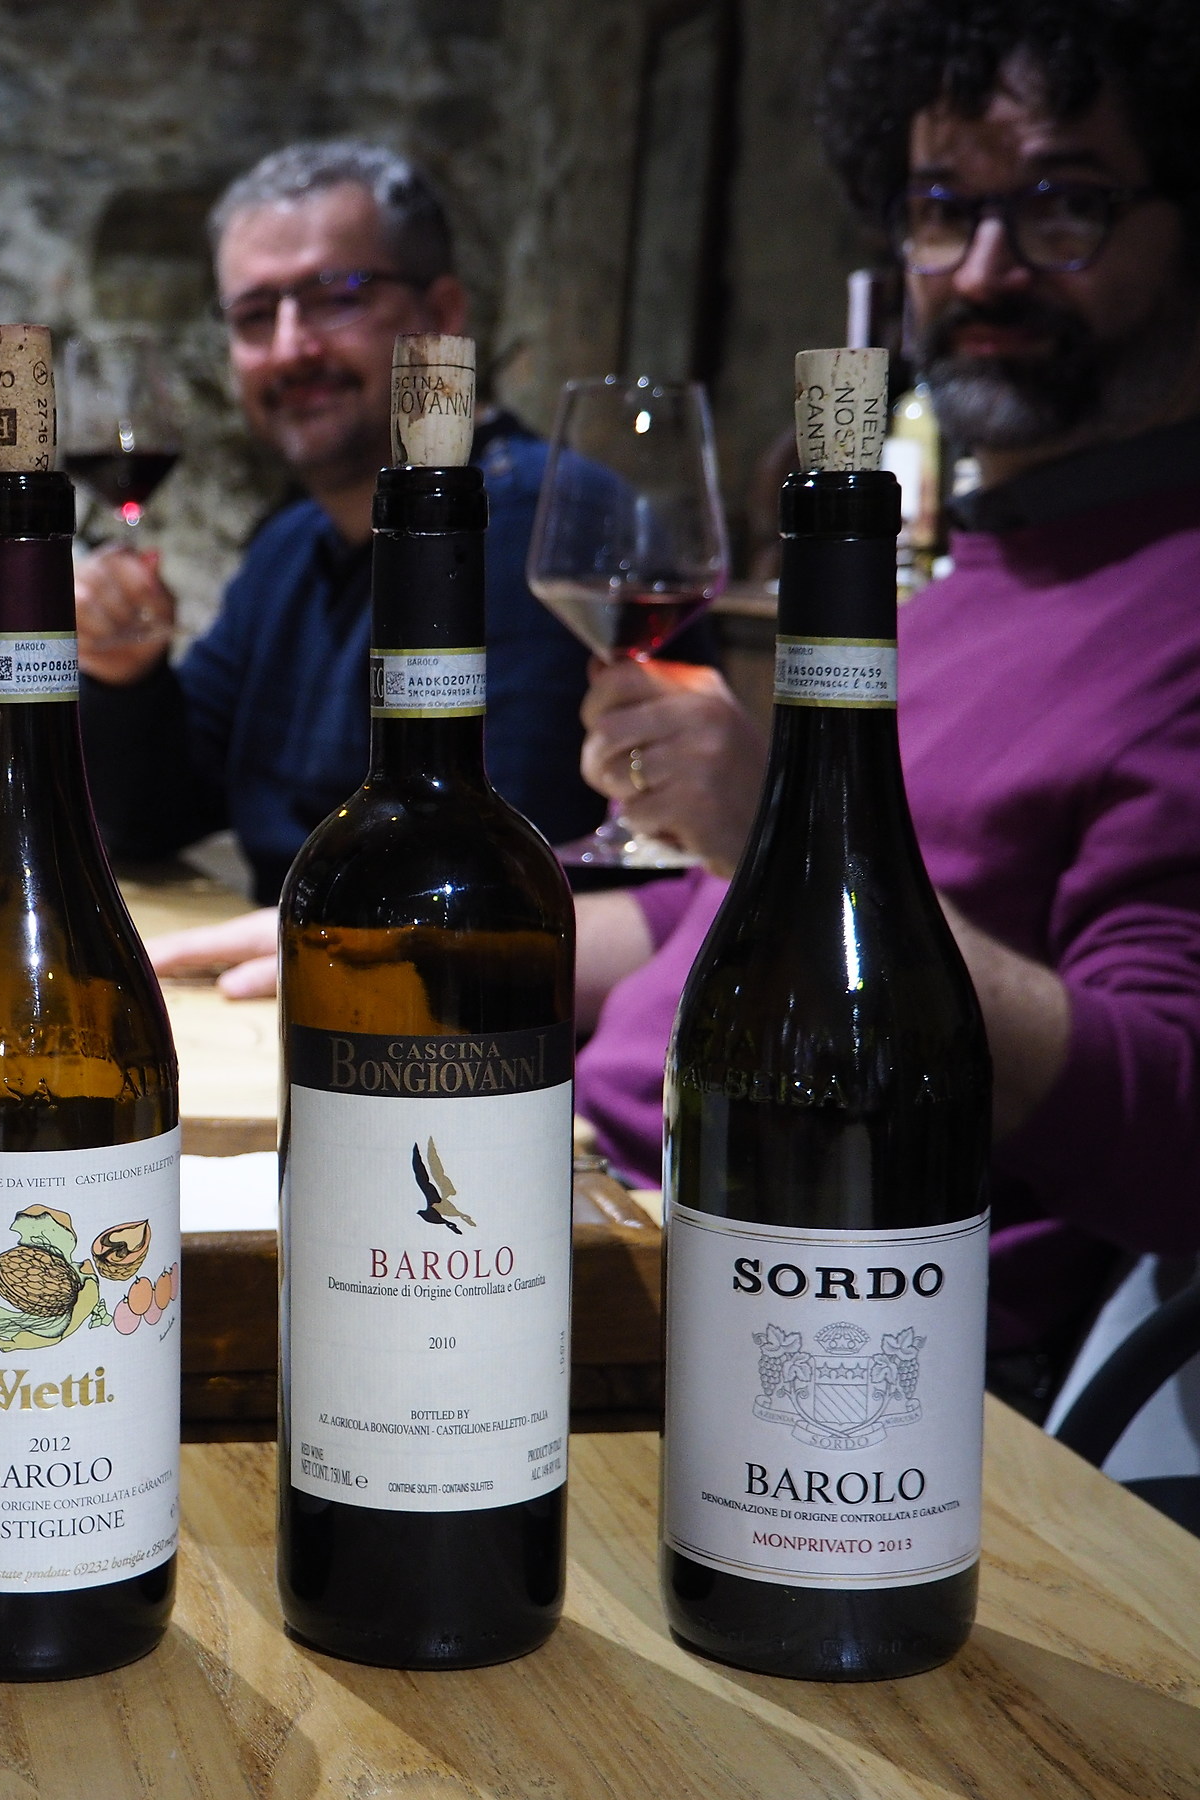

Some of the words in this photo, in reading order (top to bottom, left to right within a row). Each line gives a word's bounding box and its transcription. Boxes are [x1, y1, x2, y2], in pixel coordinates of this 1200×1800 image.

[37, 398, 48, 444] 27-16
[14, 642, 46, 651] BAROLO
[406, 658, 439, 666] BAROLO
[388, 1041, 500, 1060] CASCINA
[329, 1034, 548, 1093] BONGIOVANNI
[6, 1178, 24, 1188] DA
[27, 1176, 66, 1188] VIETTI
[75, 1166, 142, 1187] CASTIGLIONE
[143, 1155, 174, 1175] FALLETTO
[370, 1246, 515, 1281] BAROLO
[328, 1276, 399, 1297] Denominazione
[401, 1283, 411, 1297] di
[413, 1285, 452, 1301] Origine
[454, 1281, 506, 1297] Controllata
[507, 1283, 513, 1293] e
[514, 1273, 546, 1291] Garantita
[733, 1257, 946, 1302] SORDO
[428, 1336, 457, 1350] 2010
[331, 1416, 369, 1431] AGRICOLA
[371, 1422, 430, 1436] BONGIOVANNI
[436, 1422, 491, 1436] CASTIGLIONE
[492, 1415, 527, 1431] FALLETTO
[531, 1409, 548, 1424] ITALIA
[411, 1410, 455, 1420] BOTTLED
[457, 1409, 470, 1419] BY
[29, 1436, 71, 1453] 2012
[809, 1436, 869, 1449] SORDO
[1, 1500, 51, 1511] ORIGINE
[53, 1489, 130, 1510] CONTROLLATA
[132, 1487, 138, 1497] E
[138, 1469, 173, 1494] GARANTITA
[442, 1483, 469, 1494] CONTAINS
[745, 1462, 926, 1504] BAROLO
[701, 1491, 778, 1517] DENOMINAZIONE
[780, 1508, 791, 1519] DI
[794, 1511, 837, 1523] ORIGINE
[840, 1511, 911, 1523] CONTROLLATA
[912, 1509, 918, 1519] E
[920, 1500, 960, 1517] GARANTITA
[752, 1531, 873, 1554] MONPRIVATO
[878, 1538, 913, 1553] 2013
[25, 1566, 71, 1583] prodotte
[73, 1559, 109, 1576] 69232
